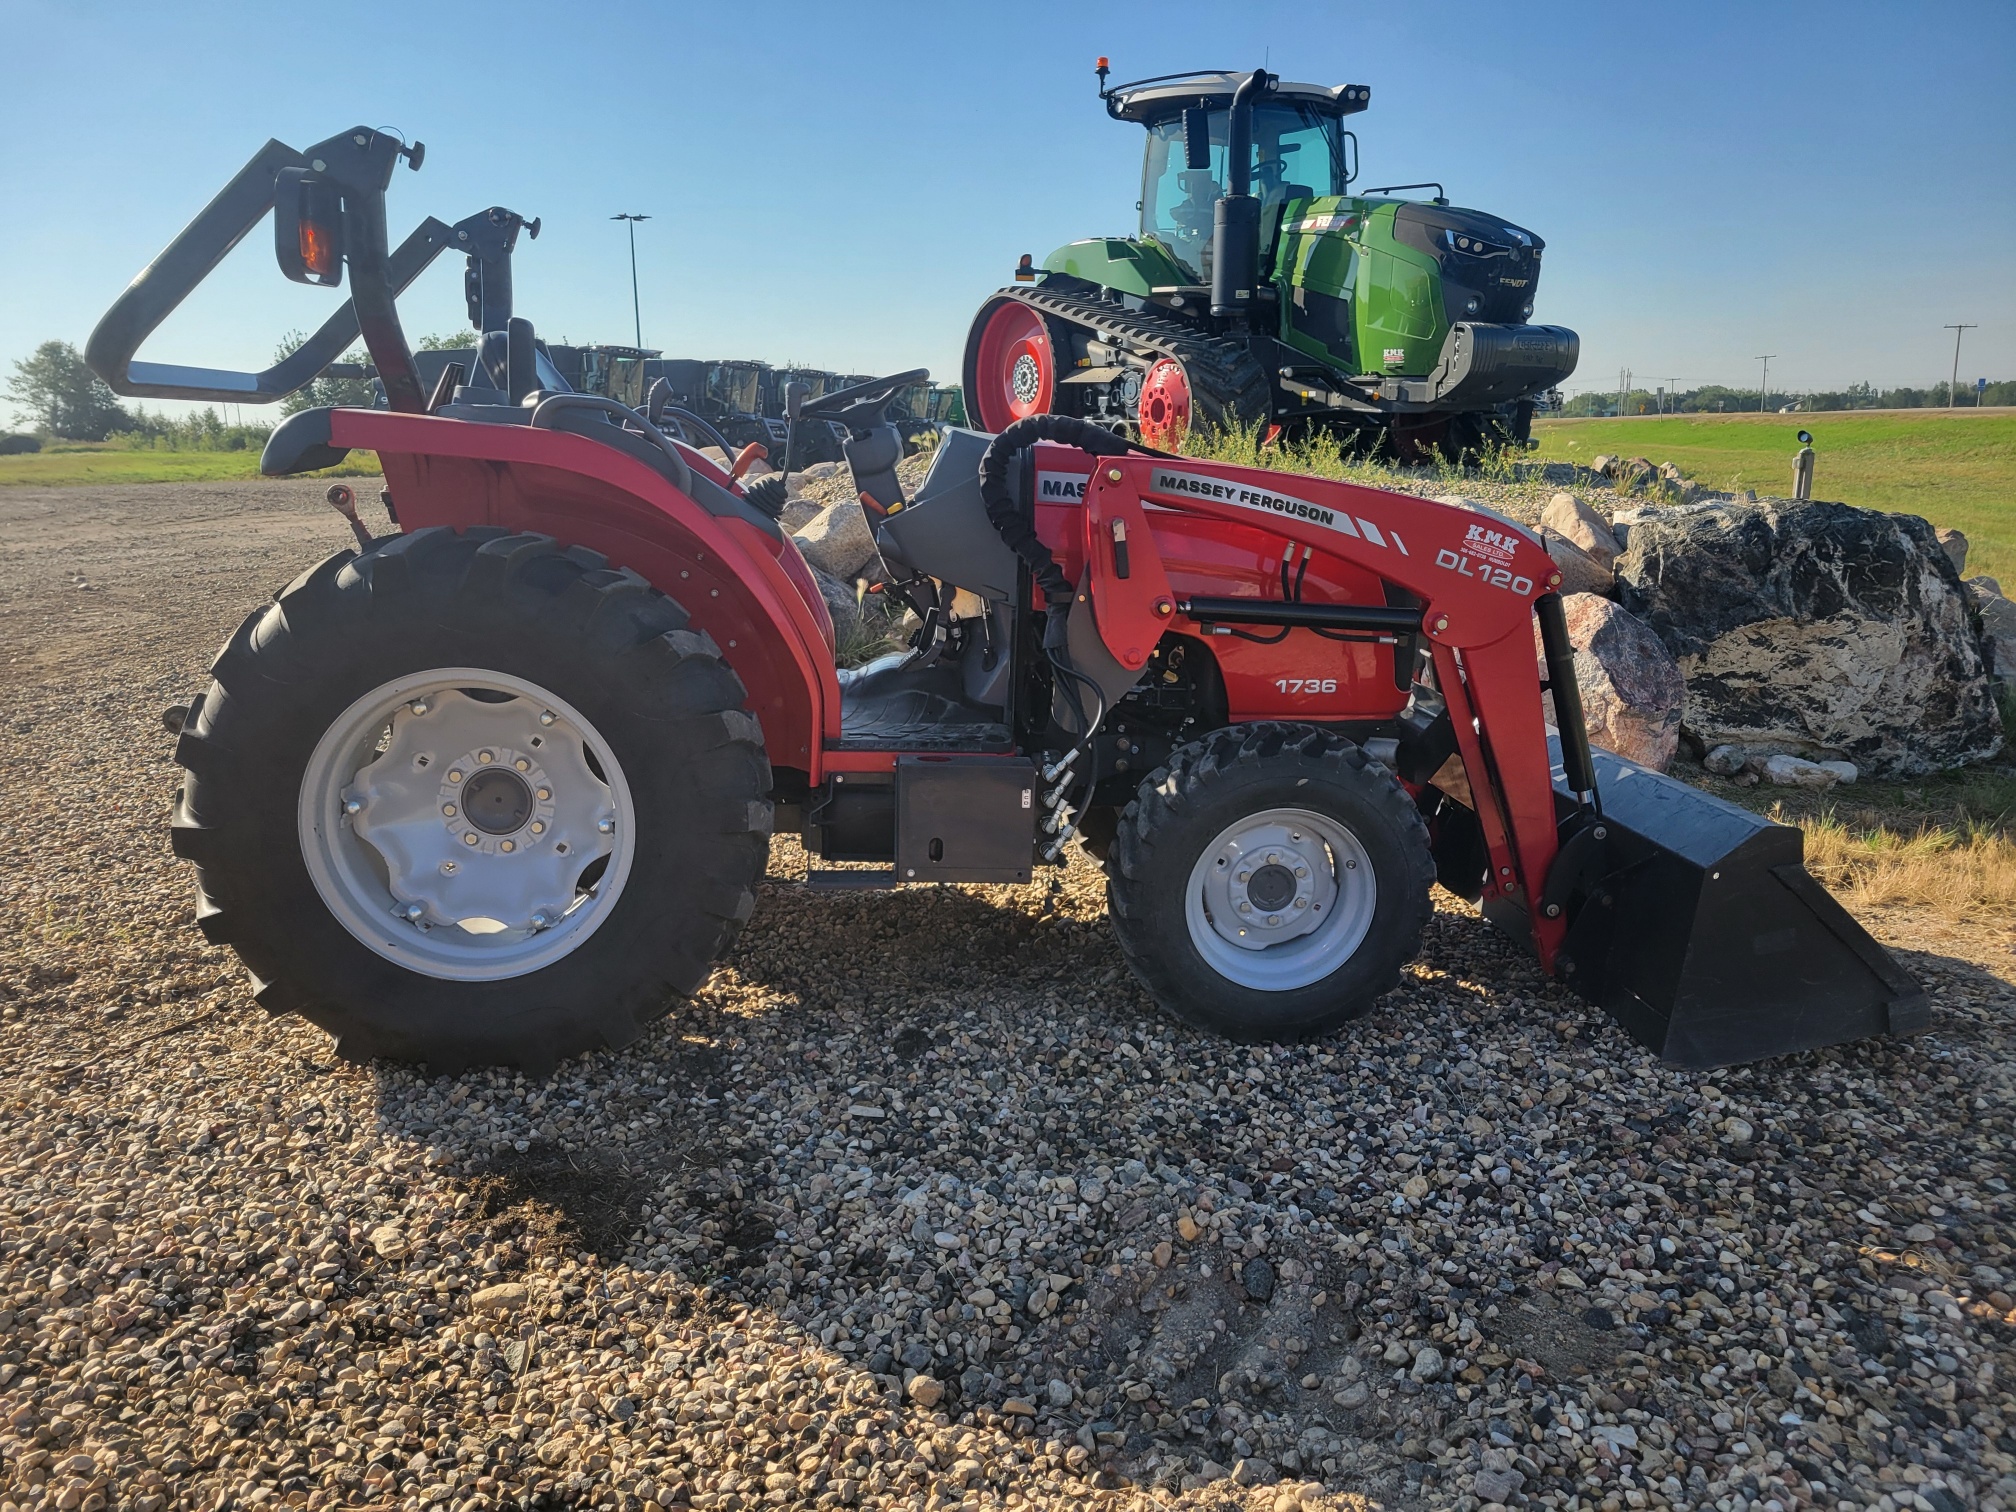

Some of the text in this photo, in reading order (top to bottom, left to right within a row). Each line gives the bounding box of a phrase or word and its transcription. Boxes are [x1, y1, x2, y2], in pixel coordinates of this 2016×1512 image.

[1042, 479, 1087, 498] MAS
[1159, 475, 1334, 525] MASSEY FERGUSON
[1472, 543, 1492, 553] SALES
[1275, 679, 1337, 694] 1736
